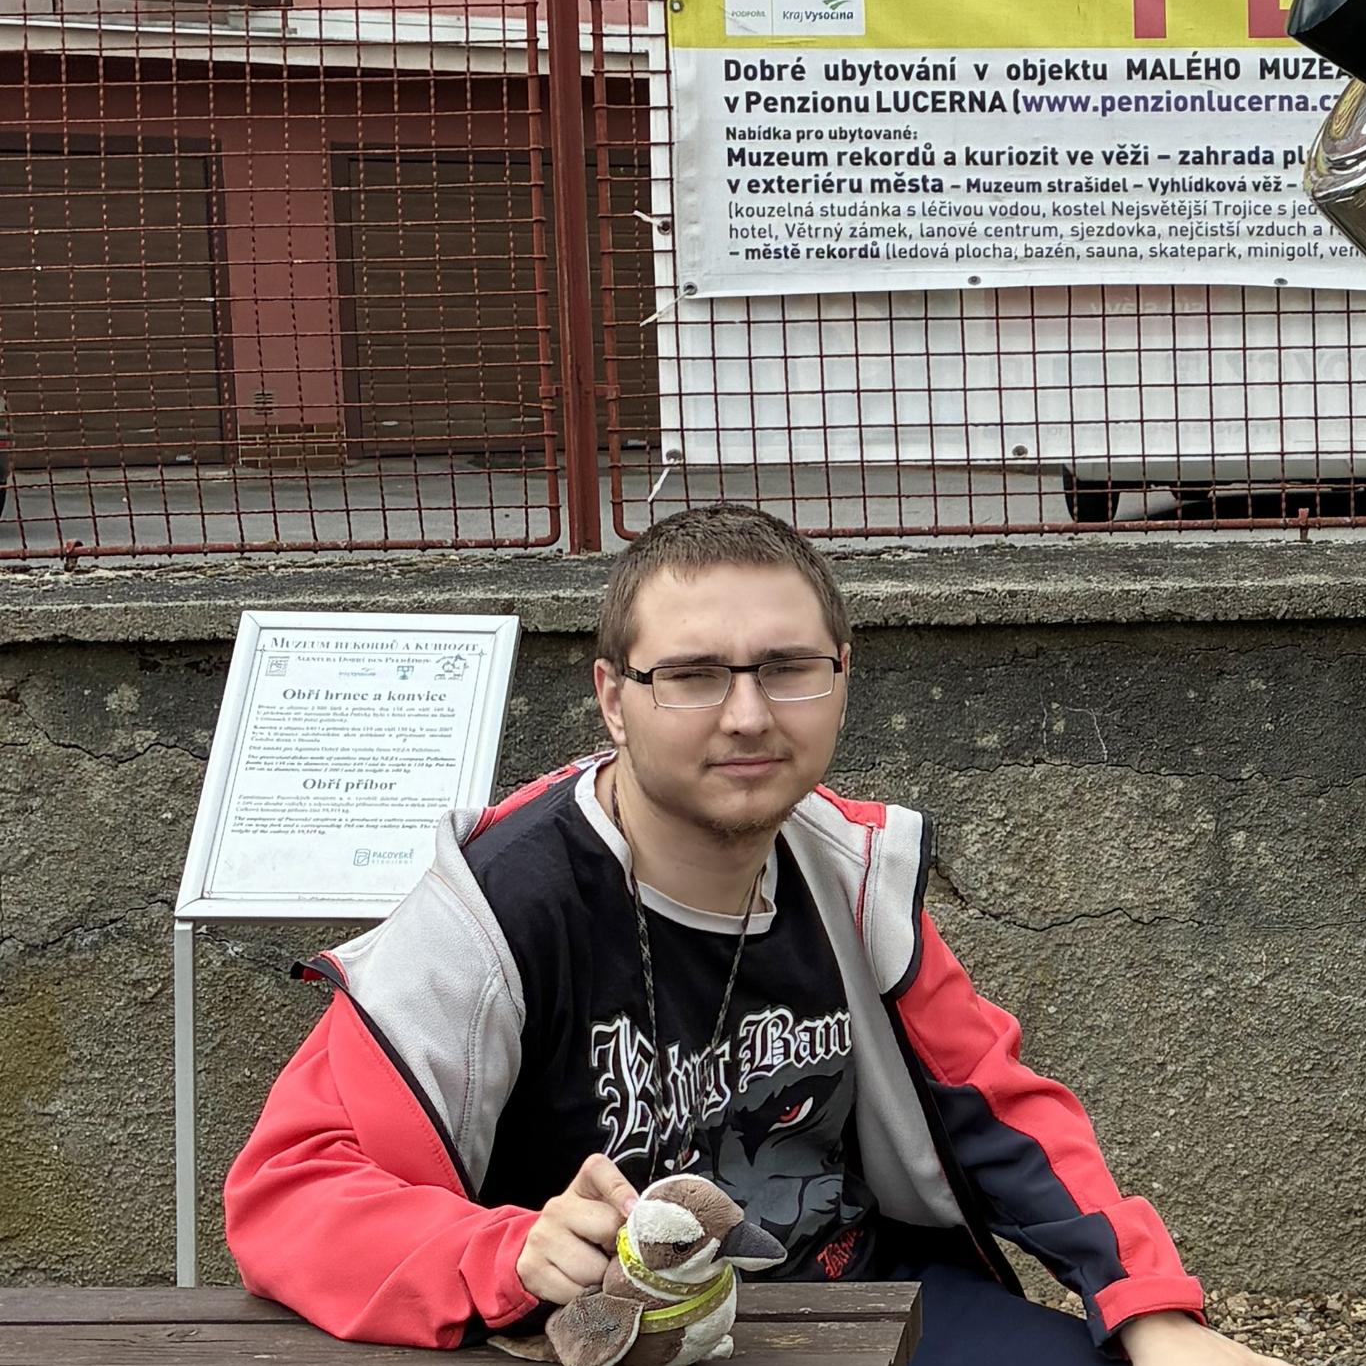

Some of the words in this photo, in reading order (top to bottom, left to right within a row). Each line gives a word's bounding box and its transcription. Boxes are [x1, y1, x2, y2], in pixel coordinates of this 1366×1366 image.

[782, 10, 803, 23] Kraj
[724, 56, 805, 81] Dobré
[824, 56, 955, 86] ubytování
[973, 63, 988, 80] v
[1006, 58, 1107, 86] objektu
[1126, 50, 1240, 80] MALÉHO
[724, 96, 739, 113] v
[745, 90, 869, 113] Penzionu
[876, 90, 1007, 112] LUCERNA
[1012, 88, 1341, 116] (www.penzionlucerna.c
[725, 125, 791, 140] Nabídka
[796, 129, 823, 143] pro
[828, 124, 917, 143] ubytované:
[727, 147, 828, 167] Muzeum
[837, 142, 935, 166] rekordů
[943, 150, 956, 166] a
[965, 145, 1058, 166] kuriozit
[1066, 150, 1093, 165] ve
[1101, 143, 1148, 165] věži
[1178, 145, 1274, 165] zahrada
[726, 178, 740, 194] v
[746, 171, 862, 193] exteriéru
[870, 171, 943, 193] města
[966, 177, 1042, 193] Muzeum
[1047, 176, 1128, 192] strašidel
[1148, 175, 1246, 195] Vyhlídková
[1251, 175, 1282, 192] věž
[728, 201, 813, 218] (kouzelná
[820, 201, 900, 217] studánka
[907, 205, 915, 216] s
[921, 200, 983, 216] léčivou
[988, 201, 1046, 220] vodou,
[1052, 201, 1105, 216] kostel
[1111, 200, 1206, 218] Nejsvětější
[1212, 200, 1272, 218] Trojice
[1277, 204, 1286, 215] s
[729, 223, 778, 240] hotel,
[784, 222, 842, 241] Větrný
[849, 221, 912, 240] zámek,
[920, 221, 977, 237] lanové
[984, 223, 1063, 238] centrum,
[1070, 222, 1160, 240] sjezdovka,
[1168, 221, 1239, 240] nejčistší
[1246, 221, 1306, 236] vzduch
[1312, 225, 1322, 236] a
[745, 243, 800, 260] městě
[805, 243, 880, 259] rekordů
[886, 242, 948, 260] (ledová
[1023, 242, 1080, 260] bazén,
[1086, 246, 1143, 259] sauna,
[1149, 242, 1241, 261] skatepark,
[1247, 242, 1323, 261] minigolf,
[283, 688, 321, 702] Obří
[325, 688, 369, 702] hrnec
[373, 693, 382, 702] a
[387, 689, 447, 702] konvice
[303, 778, 340, 791] Obří
[345, 779, 397, 793] příbor
